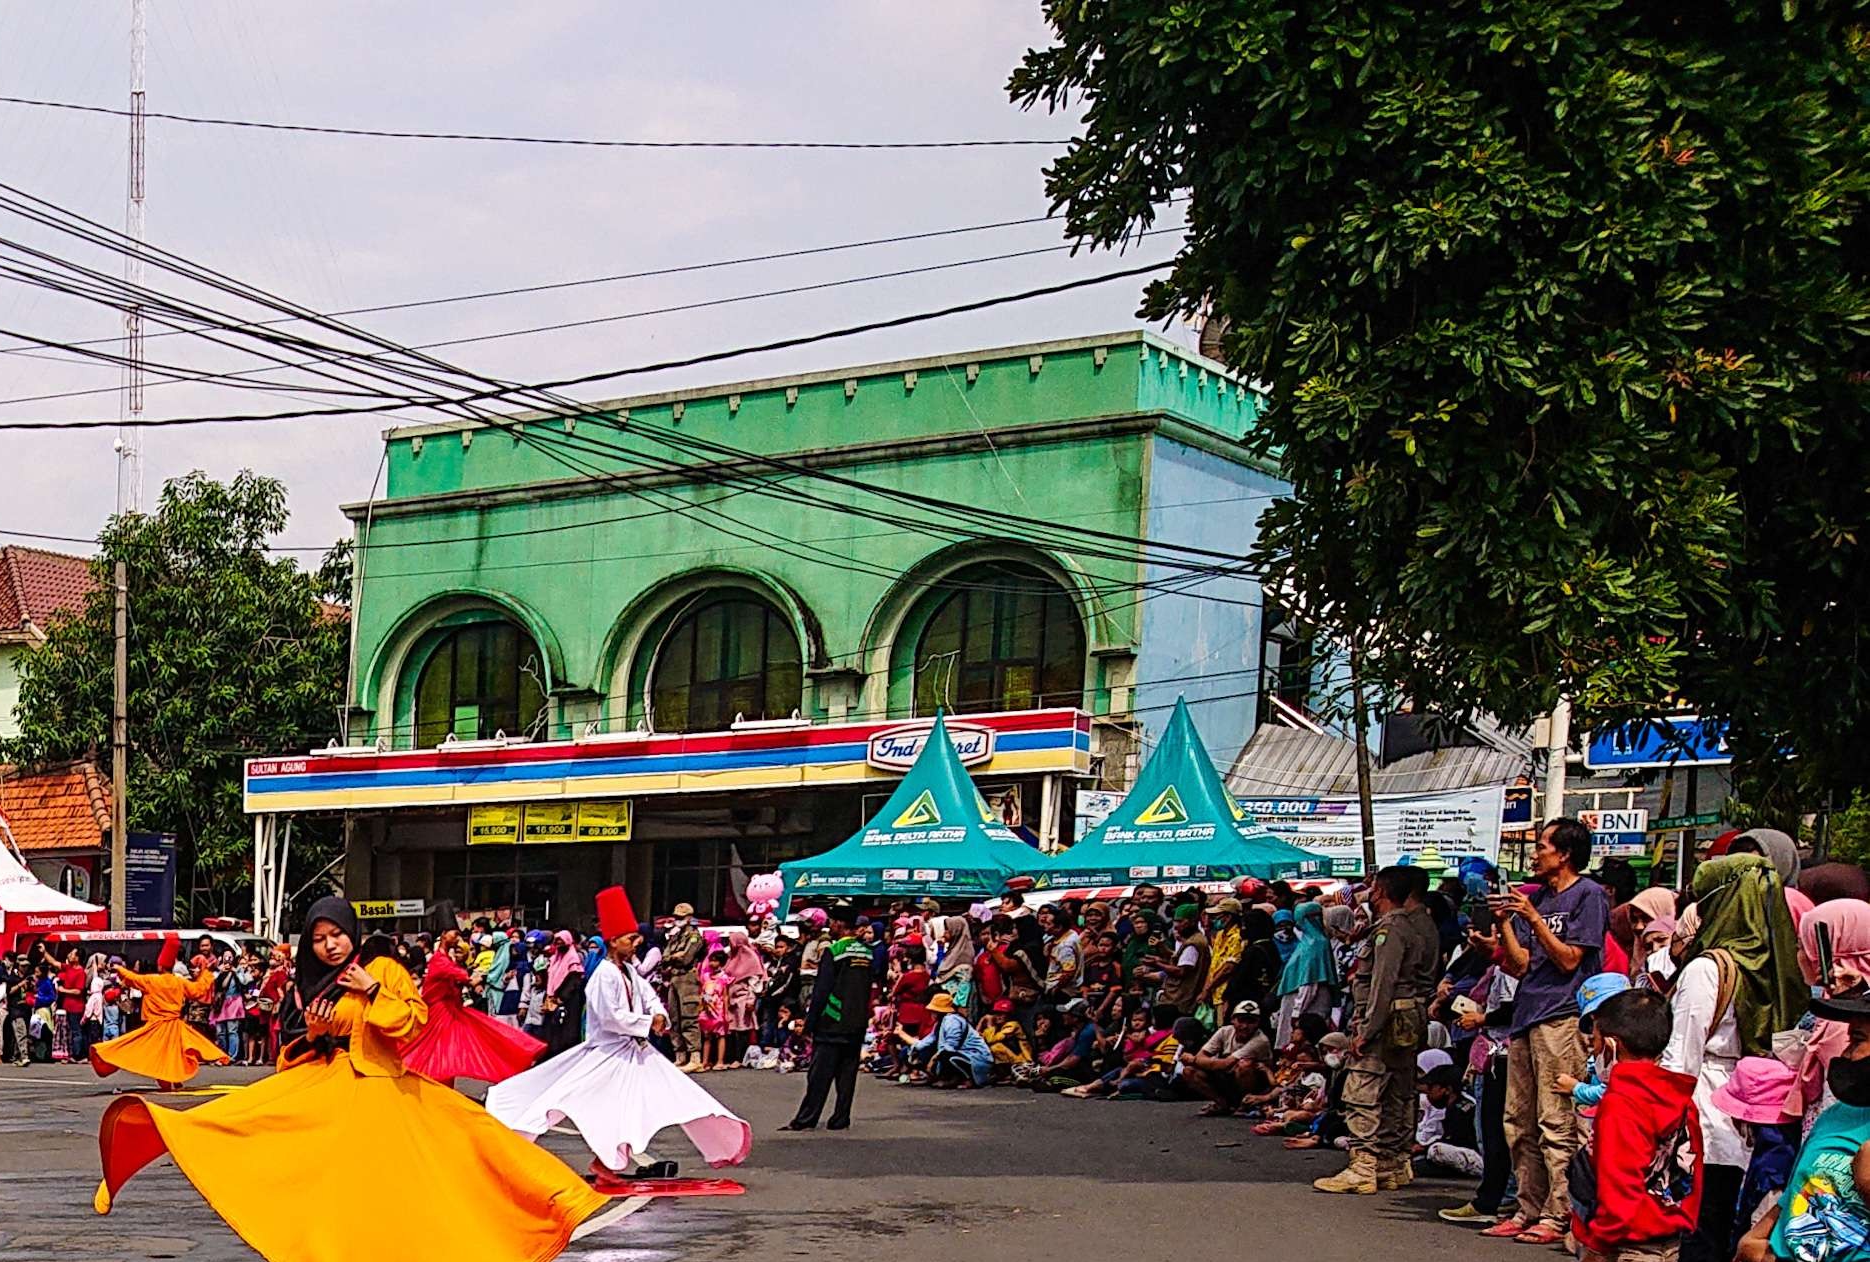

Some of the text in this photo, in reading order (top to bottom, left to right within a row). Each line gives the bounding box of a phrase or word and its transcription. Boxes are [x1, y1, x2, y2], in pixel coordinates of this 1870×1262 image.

[251, 762, 307, 775] SULTAN AGUNG
[1601, 813, 1639, 829] BNI
[864, 830, 966, 842] BANK DELTA ARTHA
[1104, 827, 1215, 840] BANK DELTA ARTHA
[1594, 834, 1619, 844] TM
[360, 904, 395, 916] Basah
[27, 915, 88, 927] Tabungan SIMPEDA
